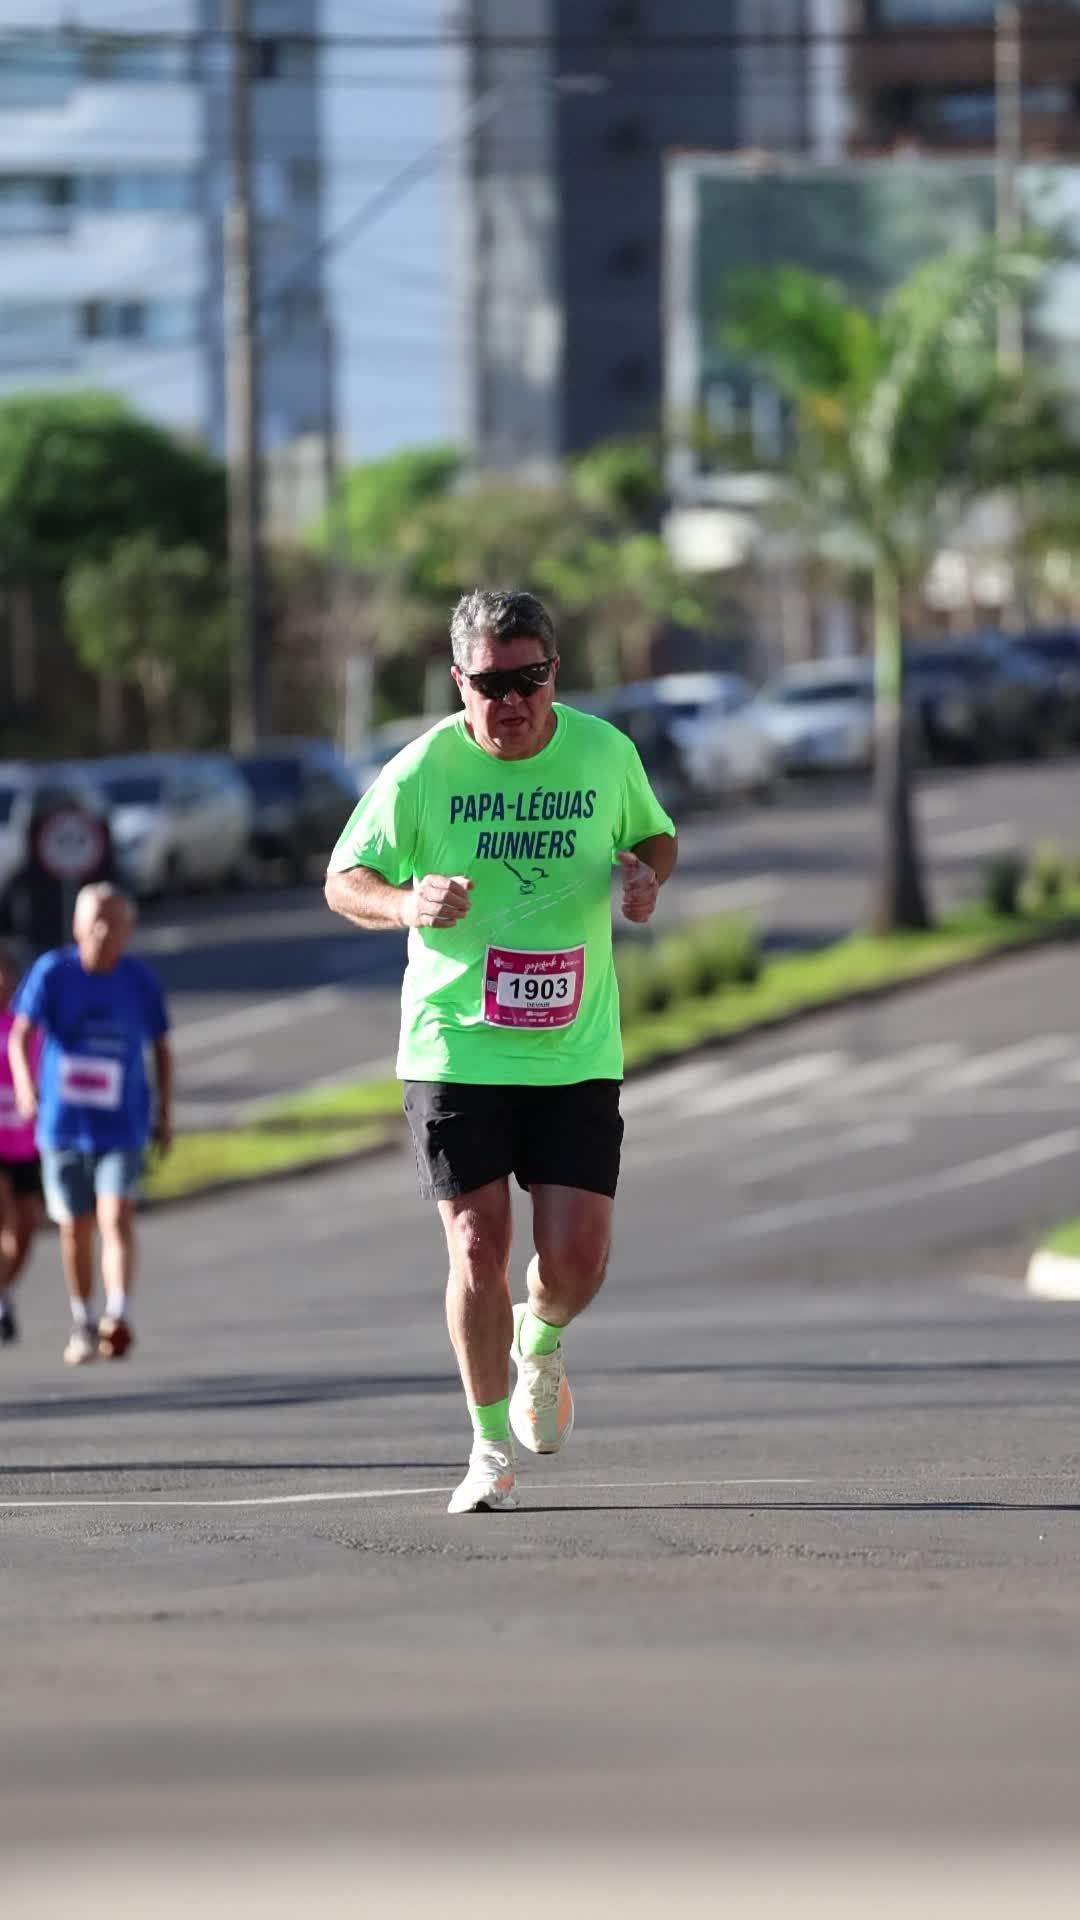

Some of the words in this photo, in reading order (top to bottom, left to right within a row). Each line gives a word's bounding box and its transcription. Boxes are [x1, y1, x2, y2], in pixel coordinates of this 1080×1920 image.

[450, 786, 597, 824] PAPA-LÉGUAS
[475, 829, 577, 859] RUNNERS
[509, 977, 568, 1000] 1903
